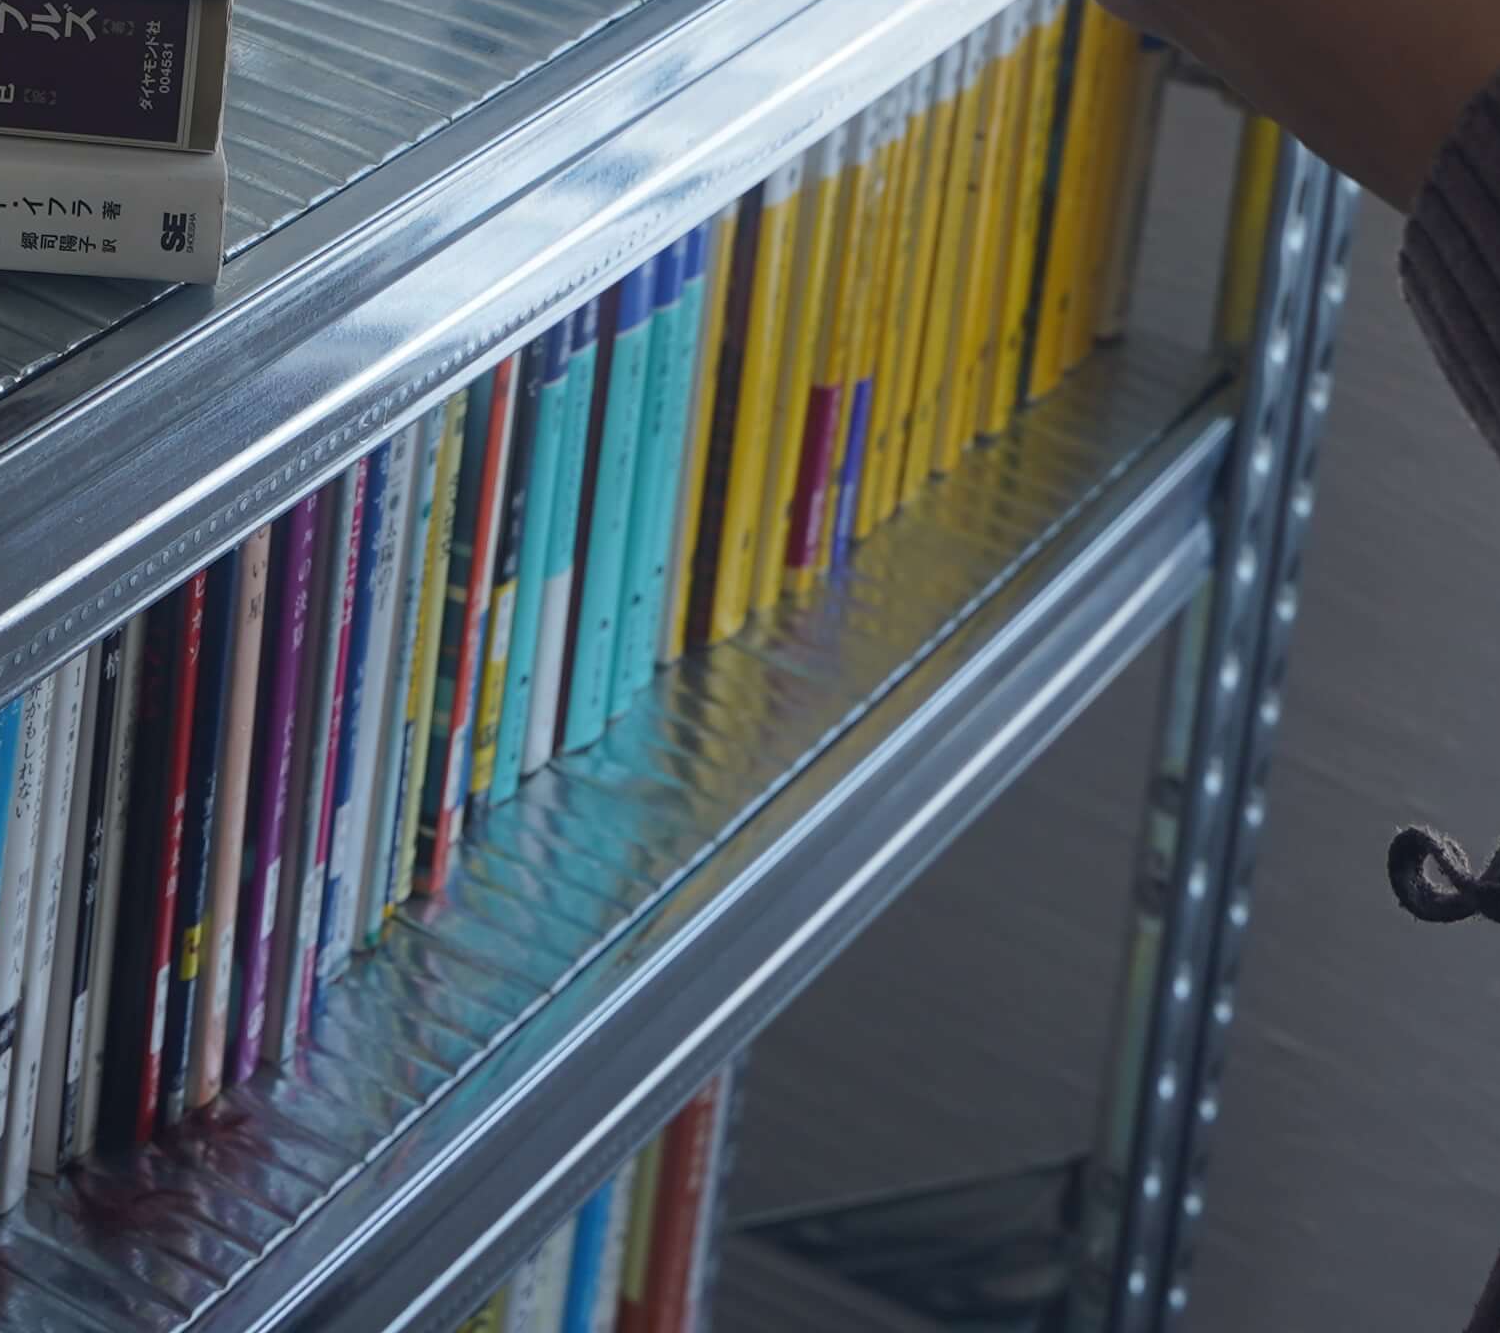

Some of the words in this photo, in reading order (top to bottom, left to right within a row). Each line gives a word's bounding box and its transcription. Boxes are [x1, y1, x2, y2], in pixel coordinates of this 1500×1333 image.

[138, 18, 162, 111] ダイヤモンド社
[158, 42, 175, 94] 004531
[101, 200, 122, 221] 著
[20, 229, 97, 255] 郷司陽子
[160, 212, 187, 253] SE
